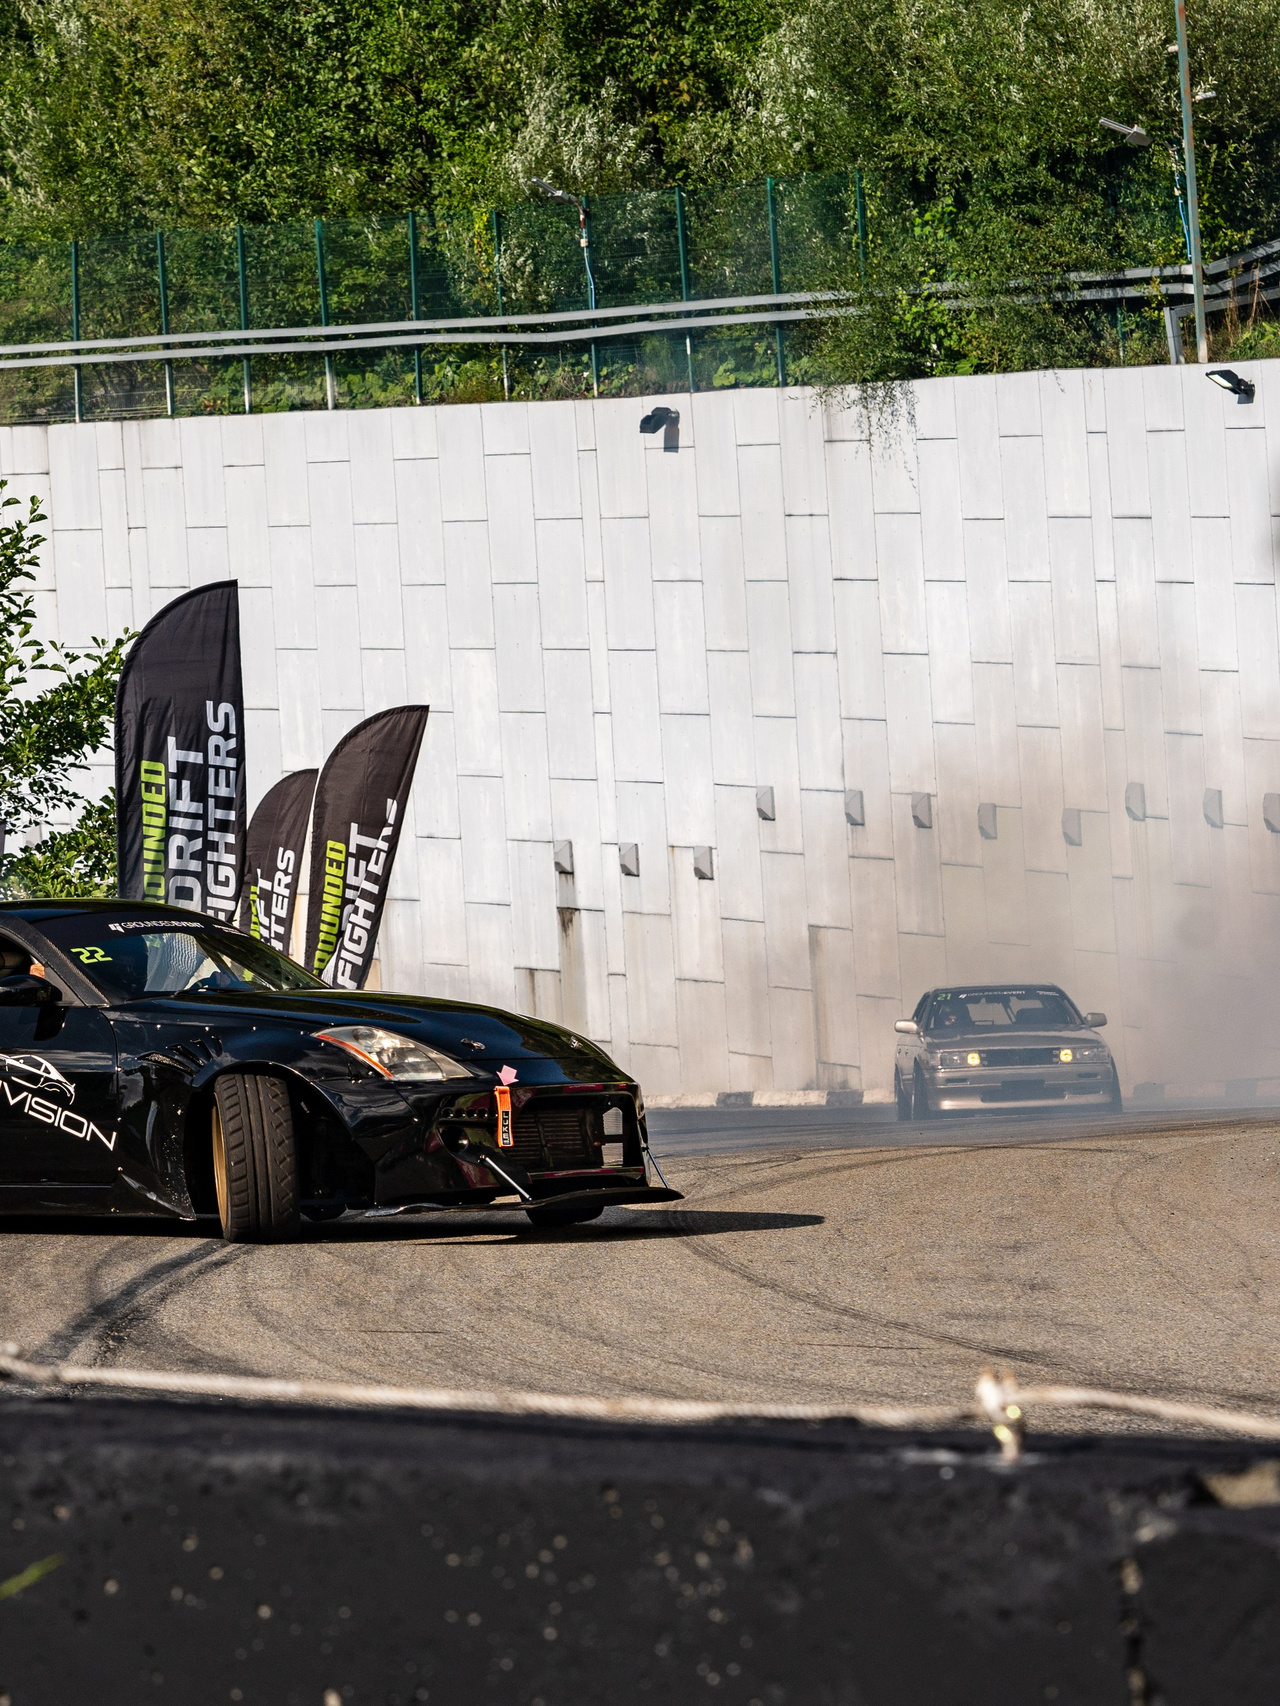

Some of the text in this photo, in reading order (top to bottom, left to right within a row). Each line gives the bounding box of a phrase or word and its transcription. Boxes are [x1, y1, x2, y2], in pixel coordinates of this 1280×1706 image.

[140, 760, 167, 905] OUNDED
[167, 736, 204, 912] DRIFT
[71, 946, 112, 964] 22
[313, 840, 346, 976] ROUNDED
[937, 993, 952, 1001] 21
